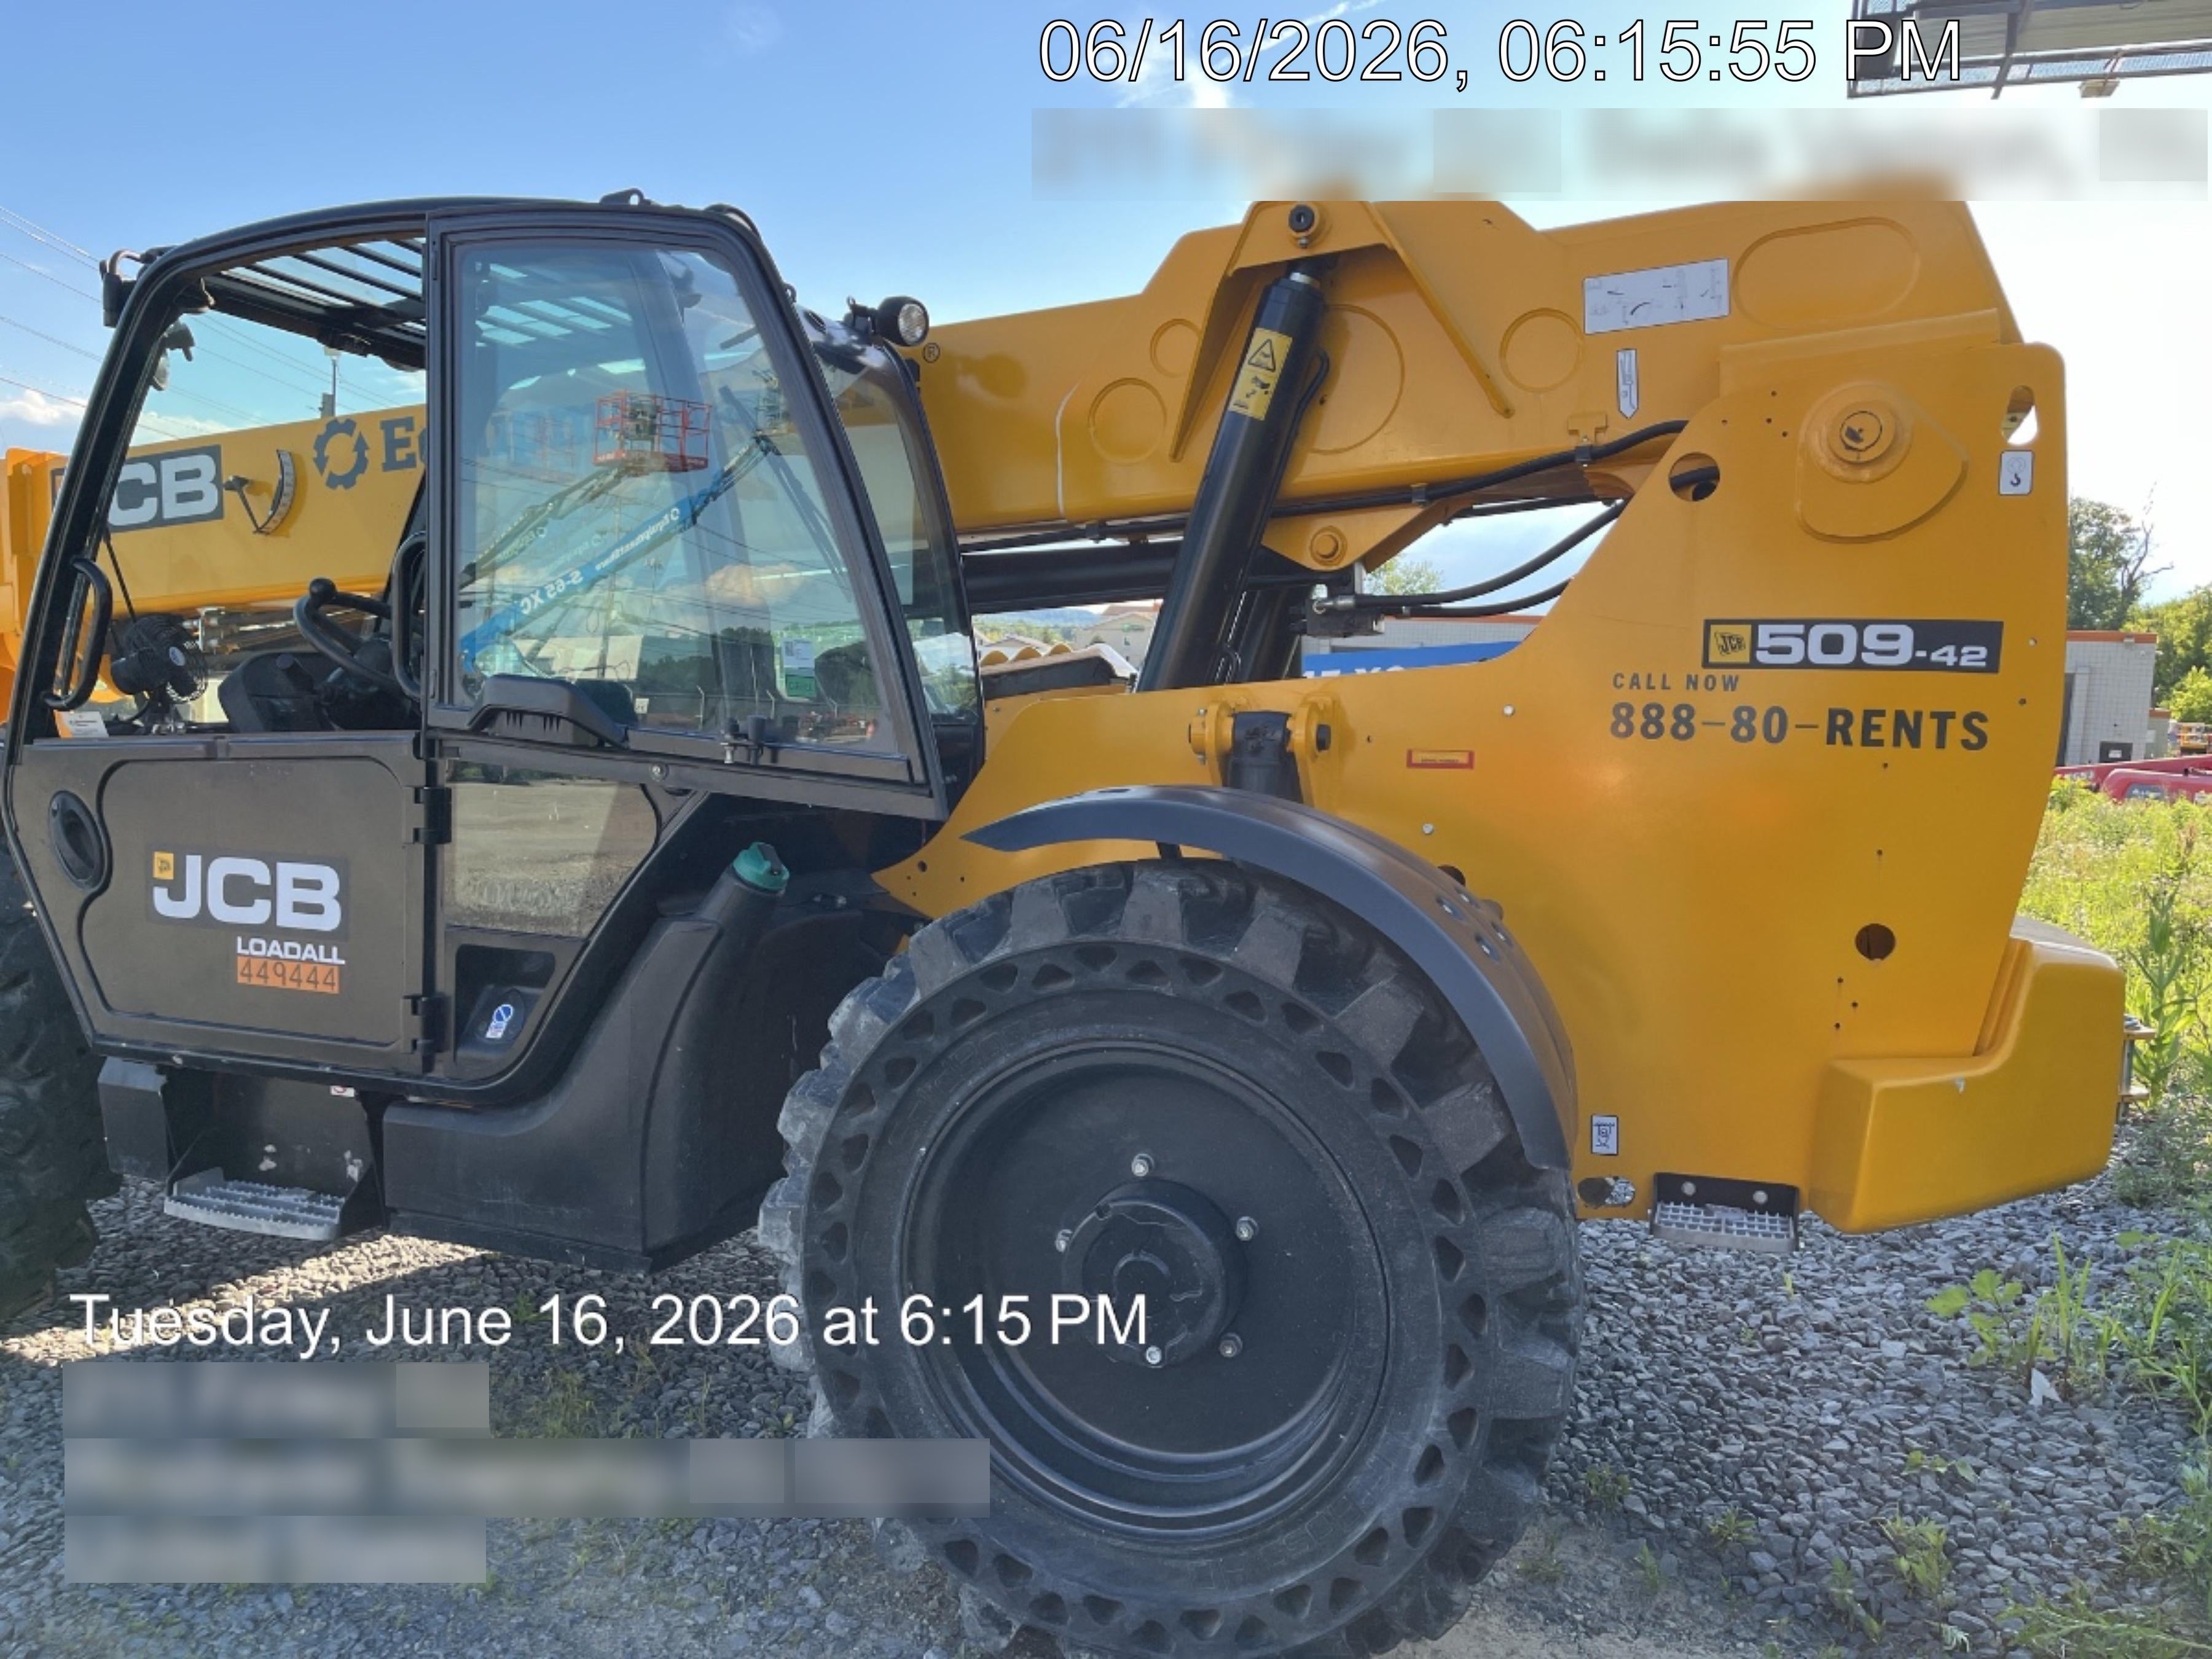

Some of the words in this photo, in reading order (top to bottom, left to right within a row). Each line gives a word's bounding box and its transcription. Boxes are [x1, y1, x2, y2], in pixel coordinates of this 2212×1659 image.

[109, 453, 220, 527] CB
[1755, 624, 1988, 667] 509-42
[1612, 672, 1672, 691] CALL
[1685, 673, 1740, 692] NOW
[1610, 702, 1990, 751] 888-80-RENTS
[153, 854, 342, 931] JCB
[236, 936, 345, 965] LOADALL
[239, 959, 337, 992] 449444
